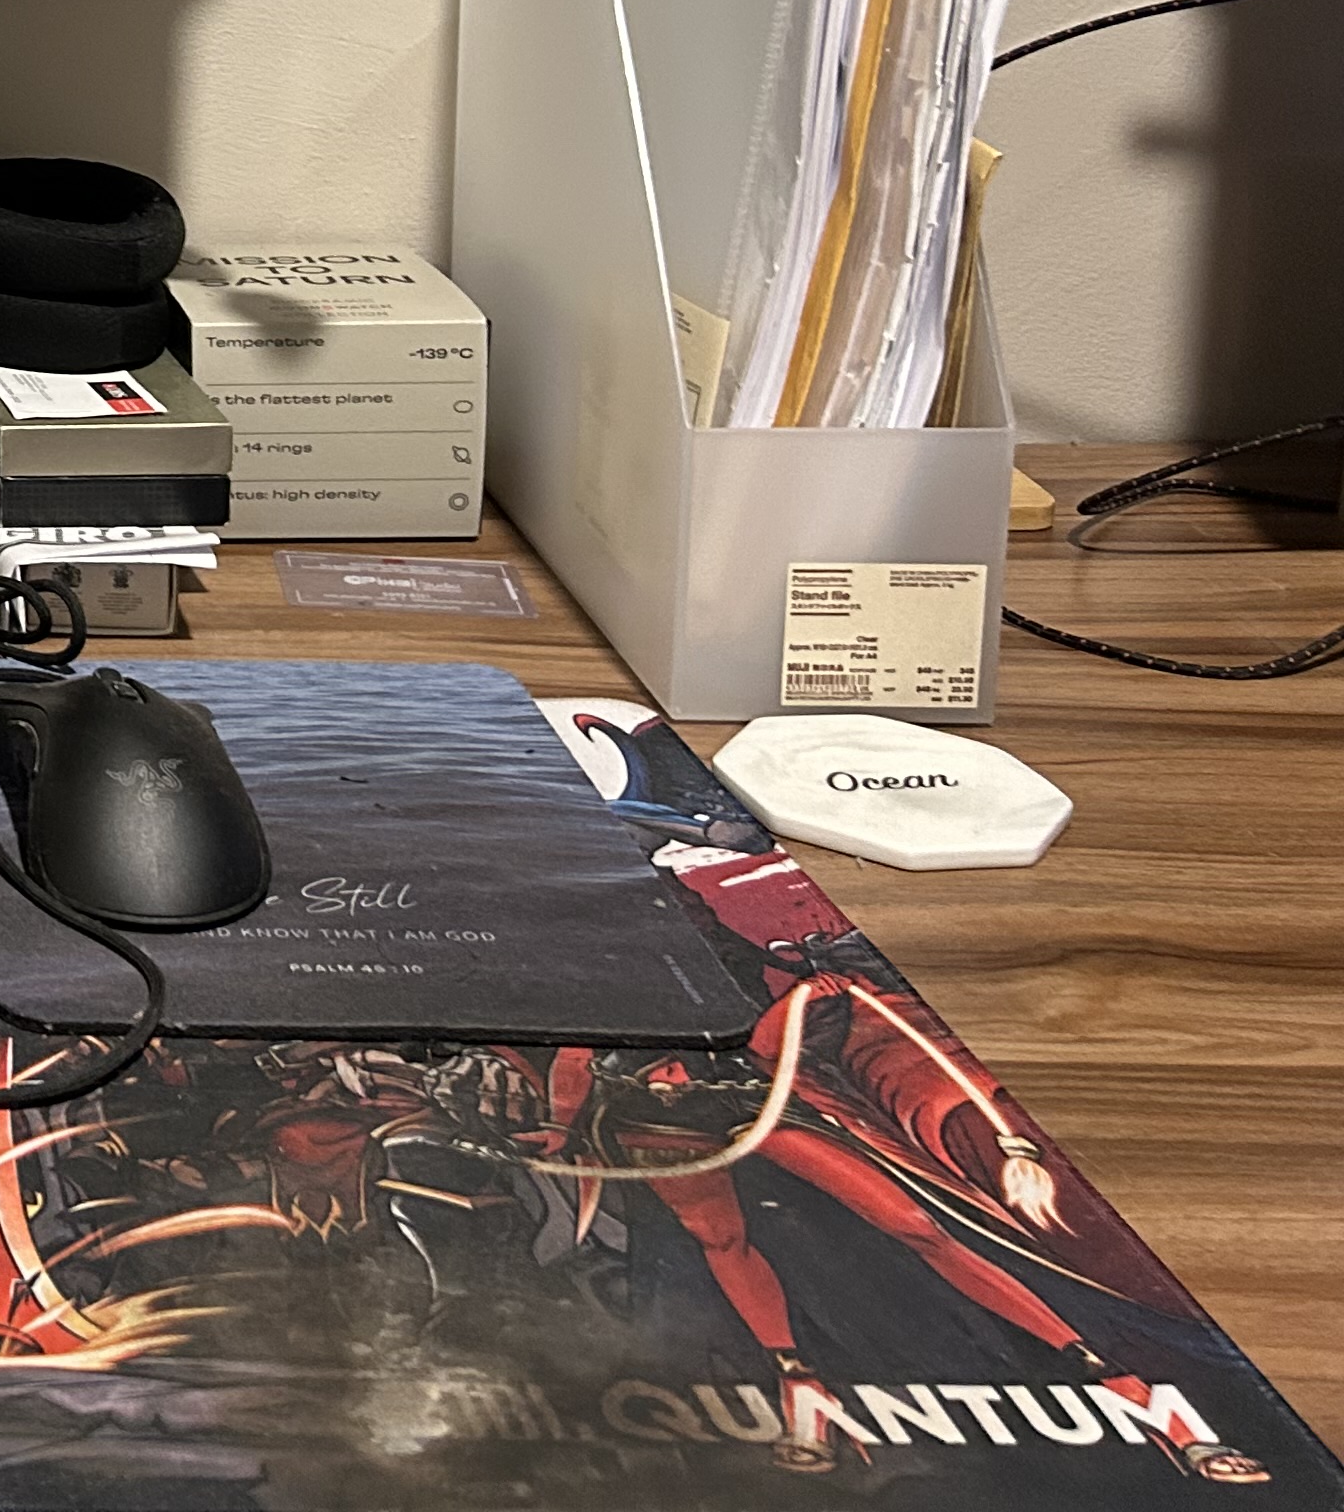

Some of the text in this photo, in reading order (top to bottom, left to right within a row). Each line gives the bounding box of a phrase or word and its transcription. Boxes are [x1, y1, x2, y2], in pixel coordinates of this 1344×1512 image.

[177, 255, 401, 266] MISSION
[254, 265, 331, 275] TO
[197, 275, 416, 287] SATURN
[205, 337, 325, 349] Temperature
[225, 394, 256, 405] the
[260, 393, 331, 405] flattest
[335, 392, 394, 405] planet
[242, 443, 313, 455] 14 rings
[272, 489, 310, 502] high
[314, 489, 381, 502] density
[791, 590, 851, 600] Stand file
[826, 771, 959, 792] Ocean
[301, 876, 417, 917] Still
[241, 927, 310, 939] KNOW
[319, 928, 377, 939] THAT
[387, 929, 395, 939] I
[404, 929, 437, 940] AM
[445, 930, 497, 942] GOD
[289, 963, 355, 974] PSALM
[602, 1375, 1221, 1446] QUANTUM
